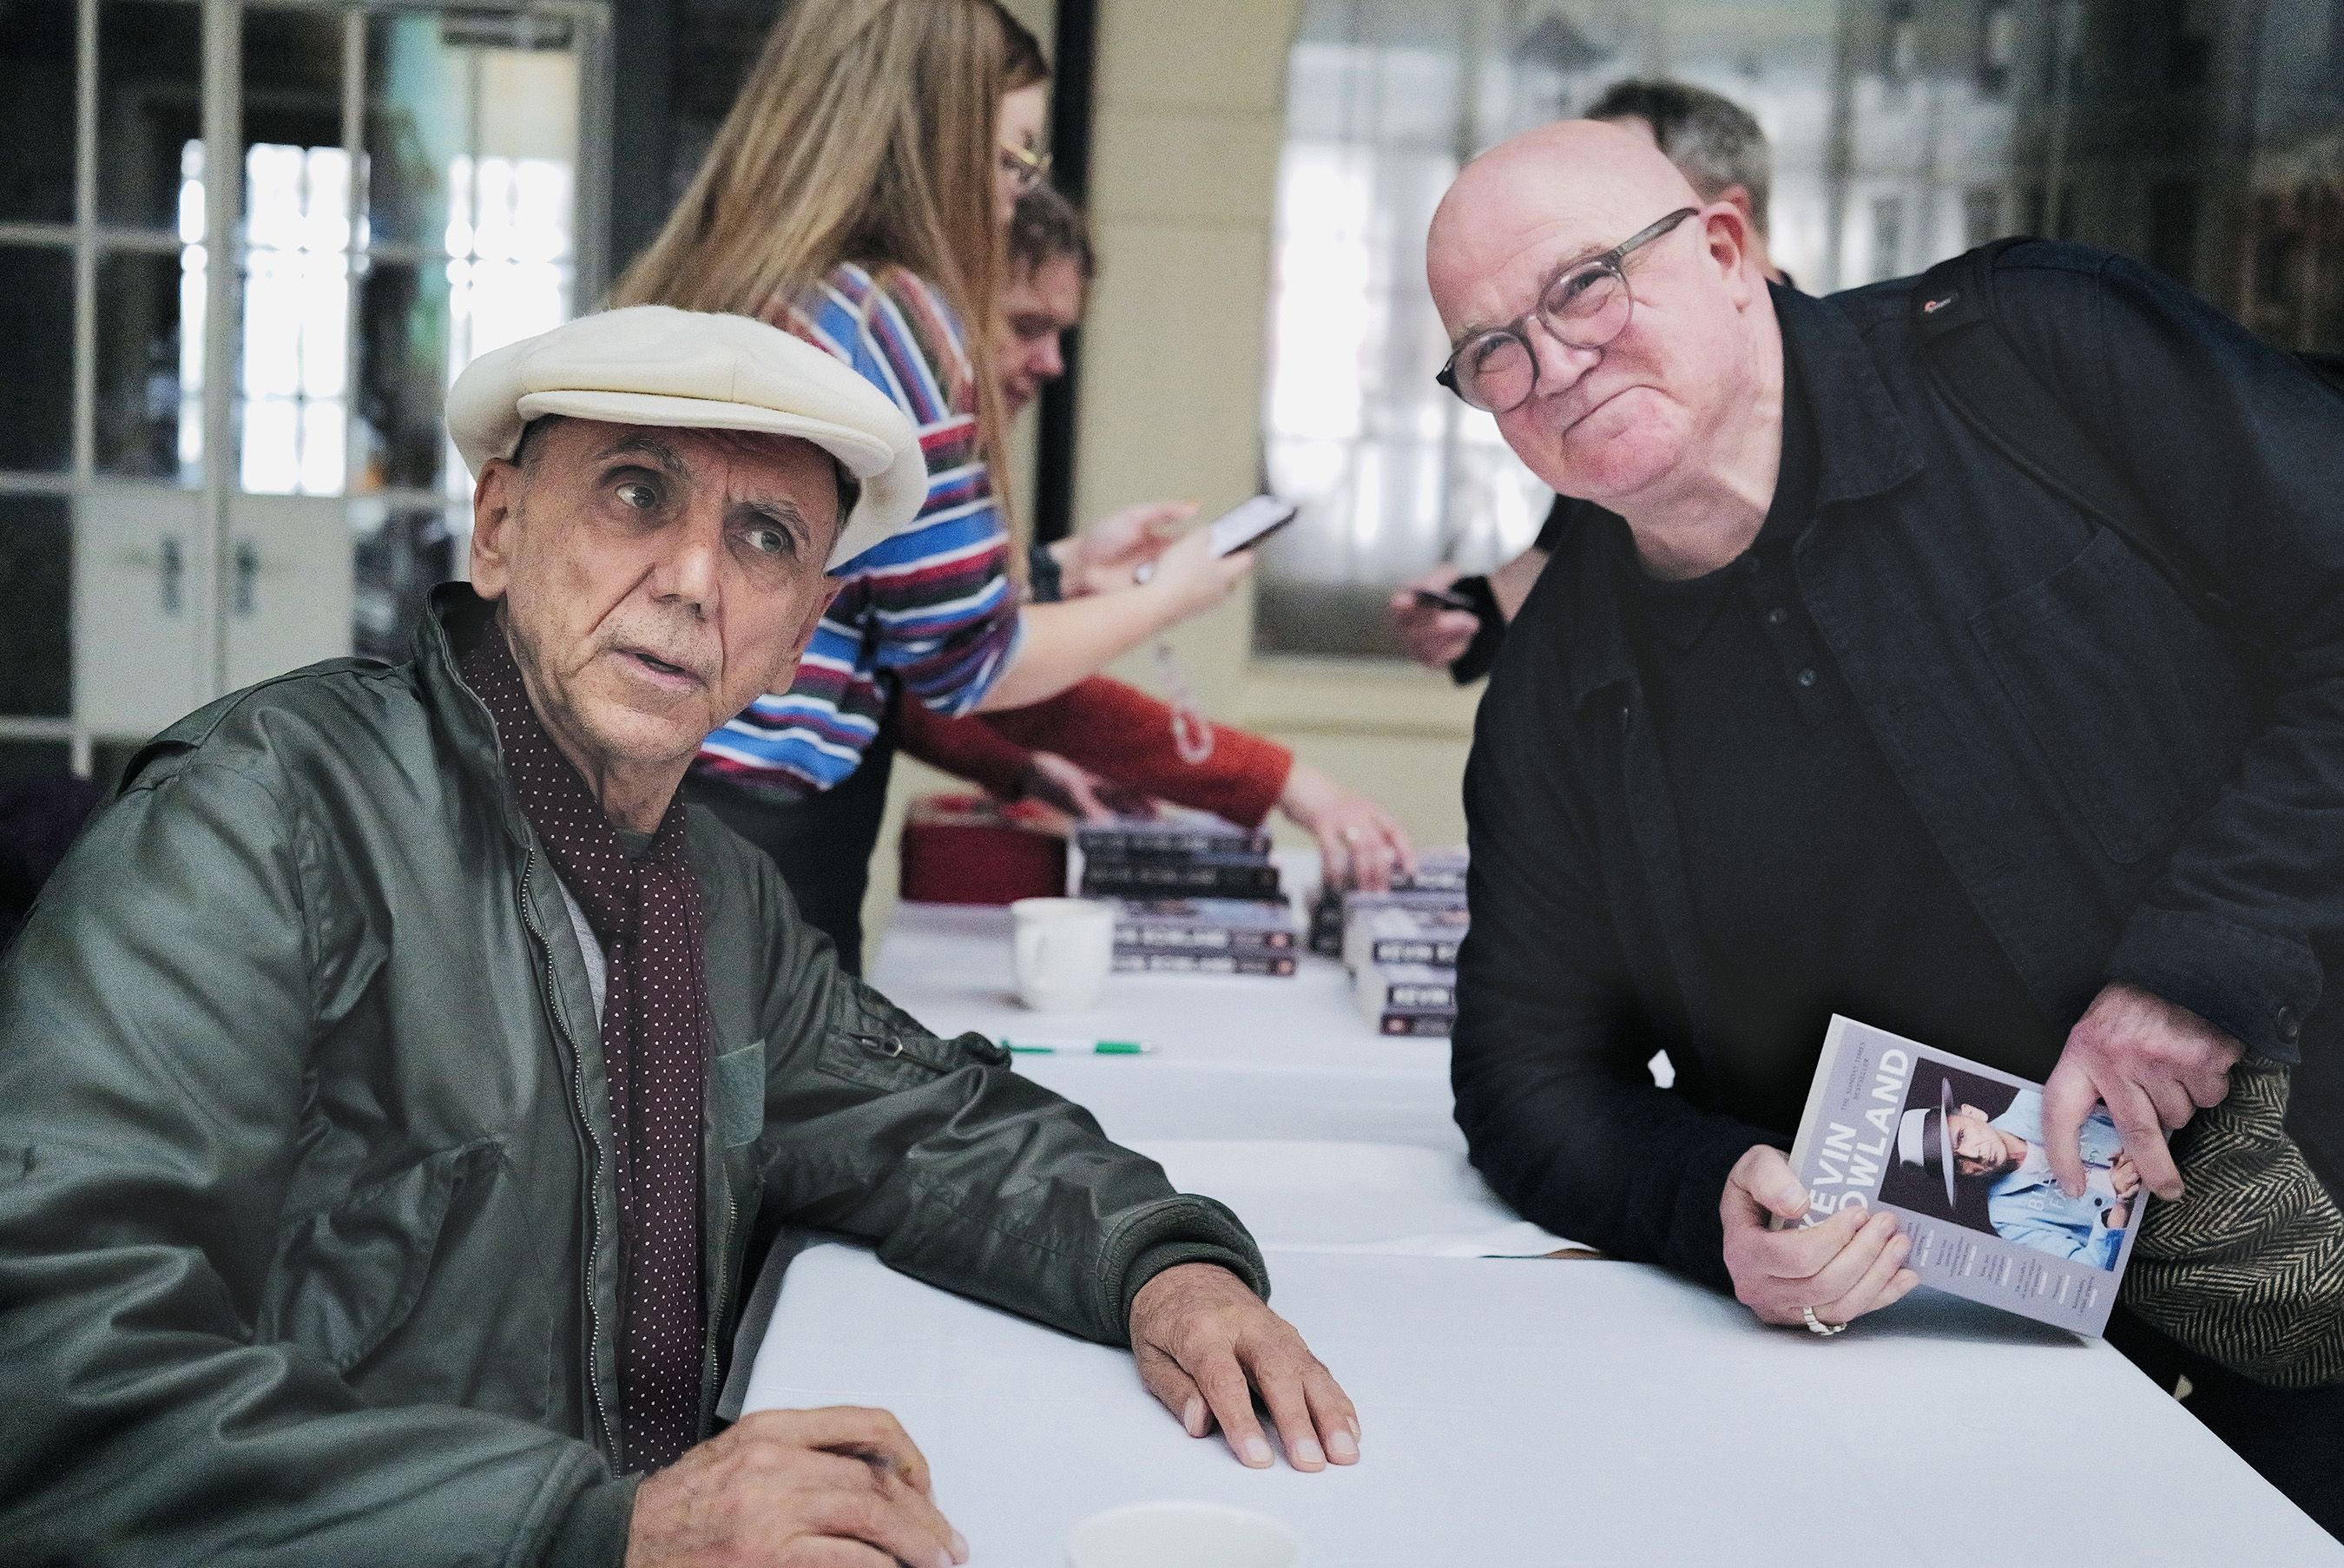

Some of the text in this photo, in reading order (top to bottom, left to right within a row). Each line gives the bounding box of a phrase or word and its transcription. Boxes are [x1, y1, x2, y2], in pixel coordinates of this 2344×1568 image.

[1840, 1040, 1866, 1111] THE SUNDAY TIMES
[1852, 1056, 1870, 1100] BESTSELLER
[1839, 1047, 1908, 1212] OWLAND
